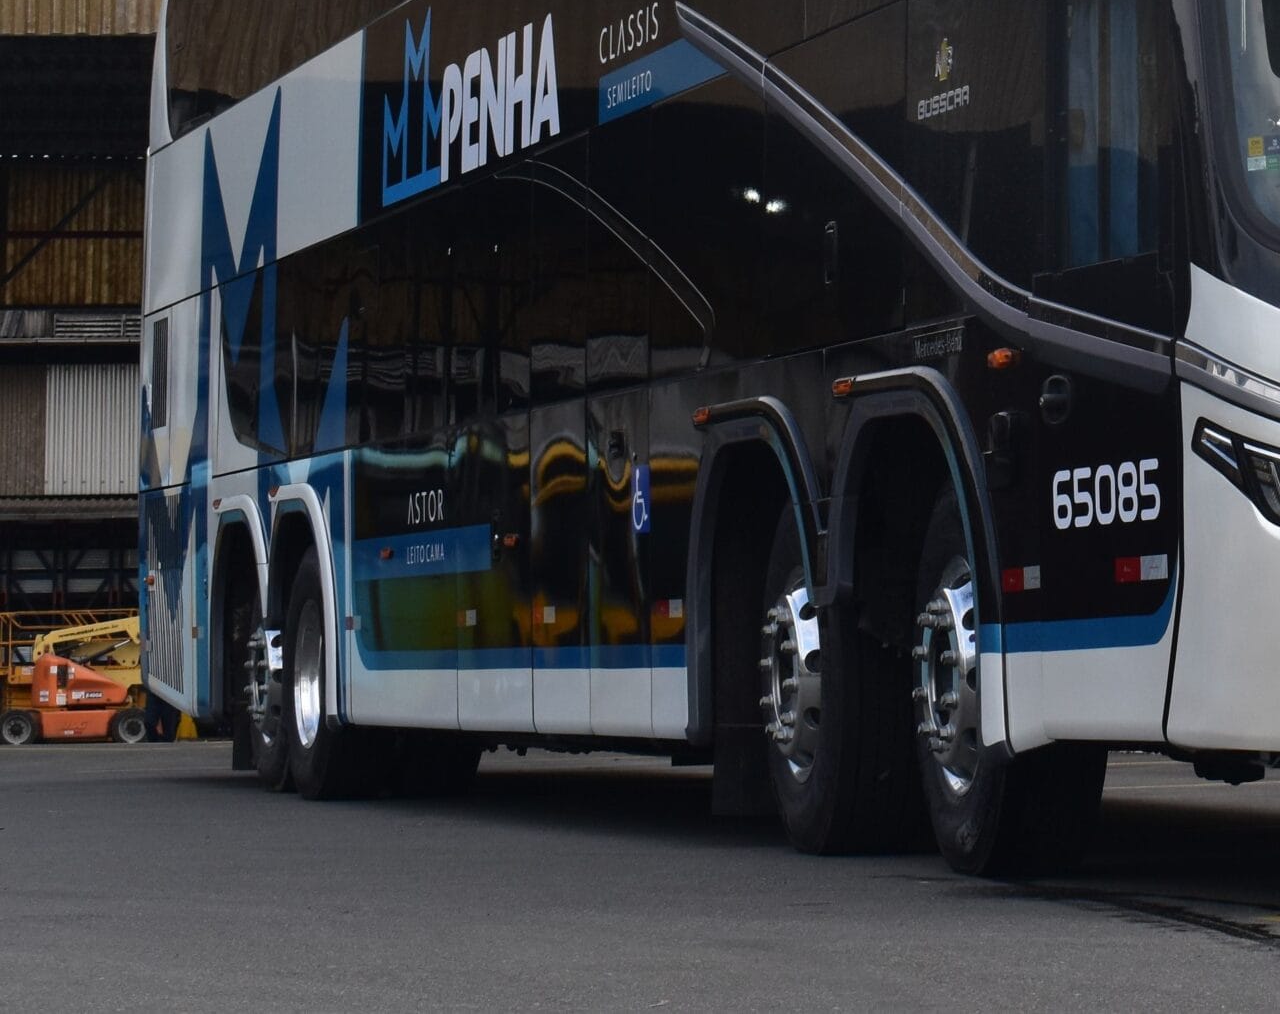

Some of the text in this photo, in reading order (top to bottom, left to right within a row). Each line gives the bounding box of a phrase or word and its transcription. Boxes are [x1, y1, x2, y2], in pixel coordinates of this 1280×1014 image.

[599, 2, 659, 64] CLASSIS
[440, 12, 560, 183] PENHA
[607, 70, 652, 109] SEMILEITO
[917, 85, 970, 120] BUSSCAR
[407, 489, 444, 525] ASTOR
[1052, 458, 1161, 530] 65085
[406, 543, 445, 564] LEITO CAMA
